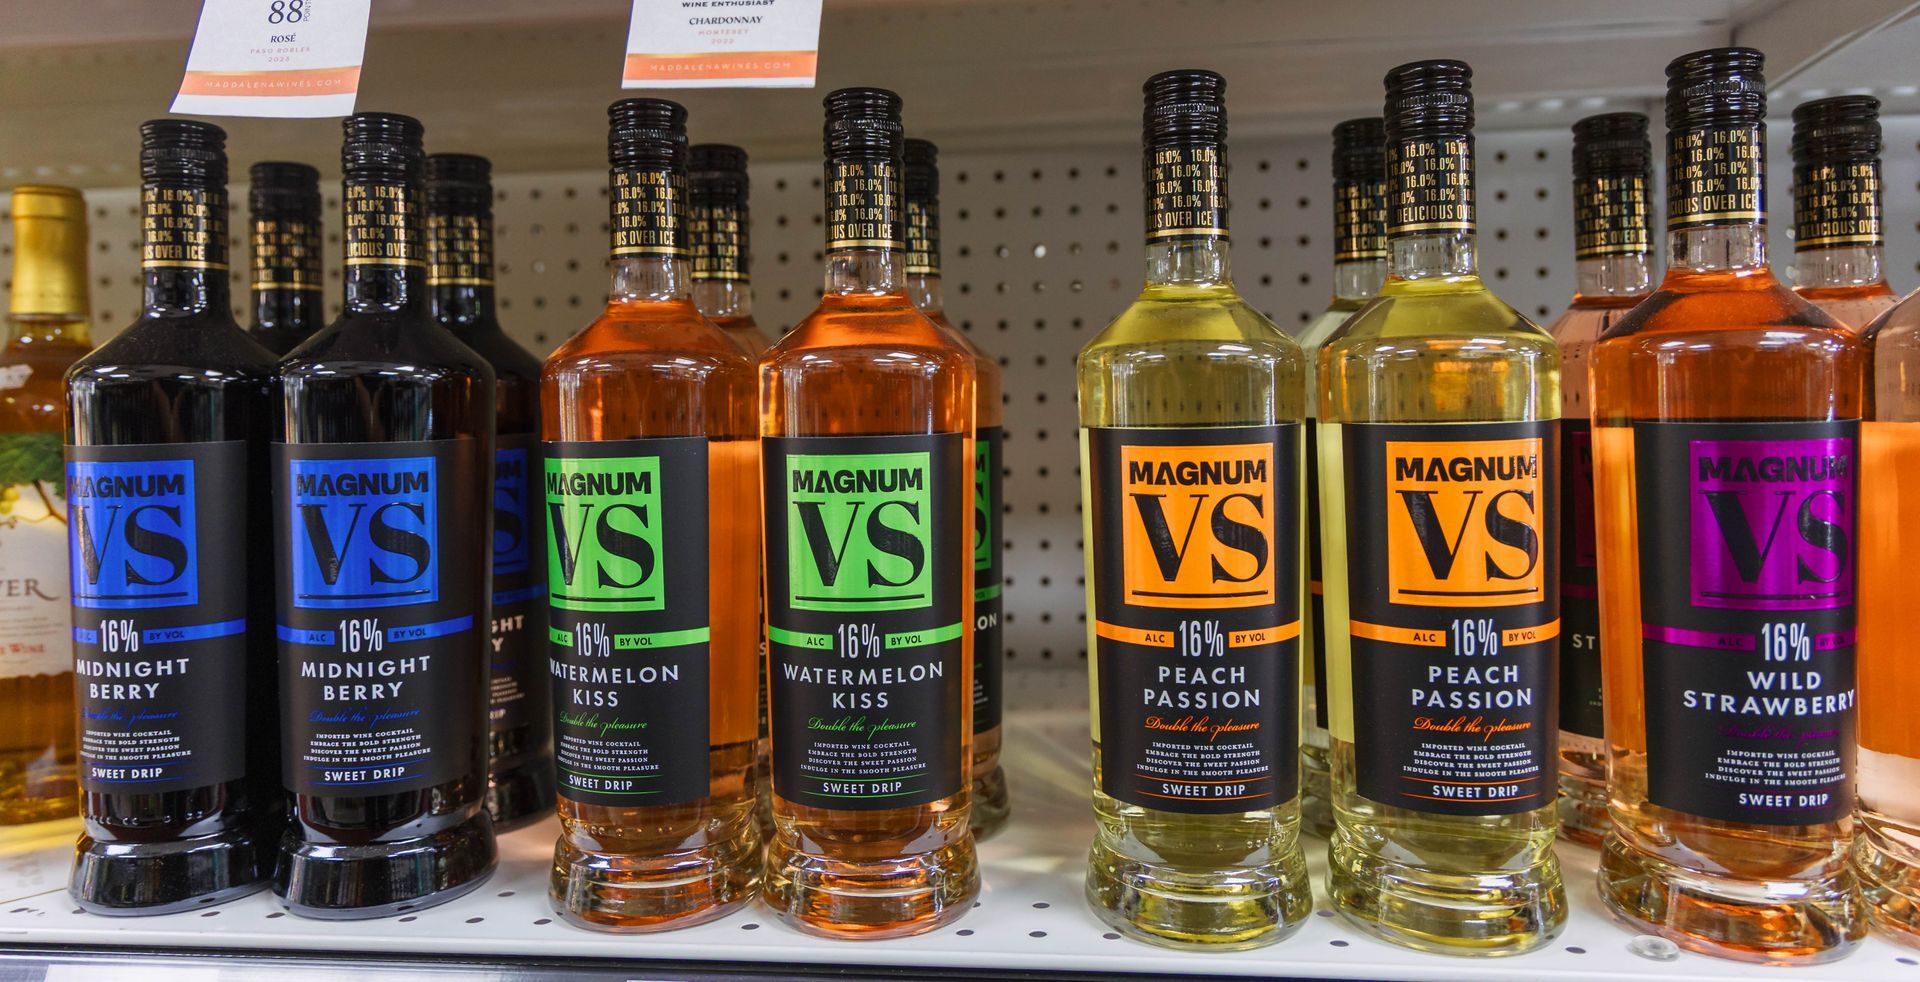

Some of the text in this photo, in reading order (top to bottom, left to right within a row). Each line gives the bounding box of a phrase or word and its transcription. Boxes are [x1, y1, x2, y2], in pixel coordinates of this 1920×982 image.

[268, 0, 303, 24] 88
[303, 0, 311, 22] POINT
[711, 0, 775, 8] ENTHUSIAST
[689, 16, 764, 26] CHARDONNAY
[271, 32, 296, 43] ROSÉ
[1713, 129, 1747, 144] 16.0%
[1156, 149, 1217, 165] 16.0% 16.0%
[1405, 142, 1470, 158] 16.0% 16.0%
[1691, 147, 1725, 162] 16.0%
[838, 164, 864, 177] 16.0%
[1171, 164, 1201, 178] 16.0%
[1425, 157, 1455, 171] 16.0%
[1714, 161, 1747, 175] 16.0%
[636, 172, 665, 185] 16.0%
[855, 178, 882, 191] 16.0%
[1156, 180, 1182, 195] 16.0%
[1405, 174, 1436, 188] 16.0%
[1691, 178, 1725, 193] 16.0%
[620, 188, 645, 200] 16.0%
[1703, 193, 1758, 211] OVER ICE
[1165, 210, 1212, 227] OVER ICE
[1397, 205, 1453, 223] DELICIOUS
[629, 231, 674, 245] OVER ICE
[848, 223, 893, 238] OVER ICE
[155, 245, 205, 260] OVER ICE
[1129, 459, 1267, 486] MAGNUM
[1395, 454, 1537, 482] MAGNUM
[1698, 455, 1848, 482] MAGNUM
[69, 474, 185, 497] MAGNUM
[297, 471, 429, 496] MAGNUM
[546, 471, 652, 495] MAGNUM
[792, 468, 923, 493] MAGNUM
[296, 502, 430, 586] VS
[548, 502, 655, 588] VS
[792, 500, 925, 588] VS
[1129, 493, 1268, 584] VS
[1395, 489, 1539, 582] VS
[1697, 490, 1848, 585] VS
[70, 504, 189, 587] VS
[100, 619, 139, 653] 16%
[149, 631, 163, 641] BY
[165, 630, 185, 640] VOL
[309, 618, 426, 653] ALC 16% BY VOL
[557, 622, 653, 657] ALC 16% BY VOL
[806, 623, 922, 658] ALC 16% BY VOL
[1145, 620, 1266, 657] ALC 16% BY VOL
[1413, 618, 1536, 657] ALC 16% BY VOL
[1761, 622, 1811, 661] 16%
[77, 658, 190, 678] MIDNIGHT
[301, 656, 431, 679] MIDNIGHT
[549, 657, 679, 684] WATERMELON
[783, 661, 943, 686] WATERMELON
[1158, 666, 1245, 685] PEACH
[1428, 665, 1518, 685] PEACH
[1747, 671, 1822, 690] WILD
[90, 682, 160, 701] BERRY
[324, 682, 403, 701] BERRY
[573, 688, 618, 707] KISS
[832, 692, 889, 709] KISS
[1144, 688, 1260, 709] PASSION
[1411, 688, 1533, 710] PASSION
[1683, 688, 1855, 716] STRAWBERRY
[559, 711, 648, 737] Double the pleasure
[807, 716, 918, 741] Double the pleasure
[1144, 715, 1261, 742] Double the pleasure
[1412, 715, 1532, 743] Double the pleasure
[808, 749, 838, 757] EMBRACE
[880, 748, 918, 756] STRENGTH
[873, 741, 911, 749] COCKTAIL
[1145, 749, 1179, 758] EMBRACE
[1223, 750, 1261, 758] STRENGTH
[1152, 742, 1254, 751] IMPORTED WINE COCKTAIL
[800, 764, 828, 773] INDULGE
[892, 763, 927, 772] PLEASURE
[808, 757, 841, 765] DISCOVER
[887, 756, 917, 764] PASSION
[1137, 764, 1169, 774] INDULGE
[1236, 765, 1269, 775] PLEASURE
[1146, 757, 1182, 766] DISCOVER
[92, 767, 163, 779] SWEET DRIP
[324, 767, 405, 781] SWEET DRIP
[569, 774, 633, 791] SWEET DRIP
[823, 781, 902, 794] SWEET DRIP
[1162, 783, 1246, 797] SWEET DRIP
[1432, 785, 1519, 798] SWEET DRIP
[1739, 793, 1829, 808] SWEET DRIP
